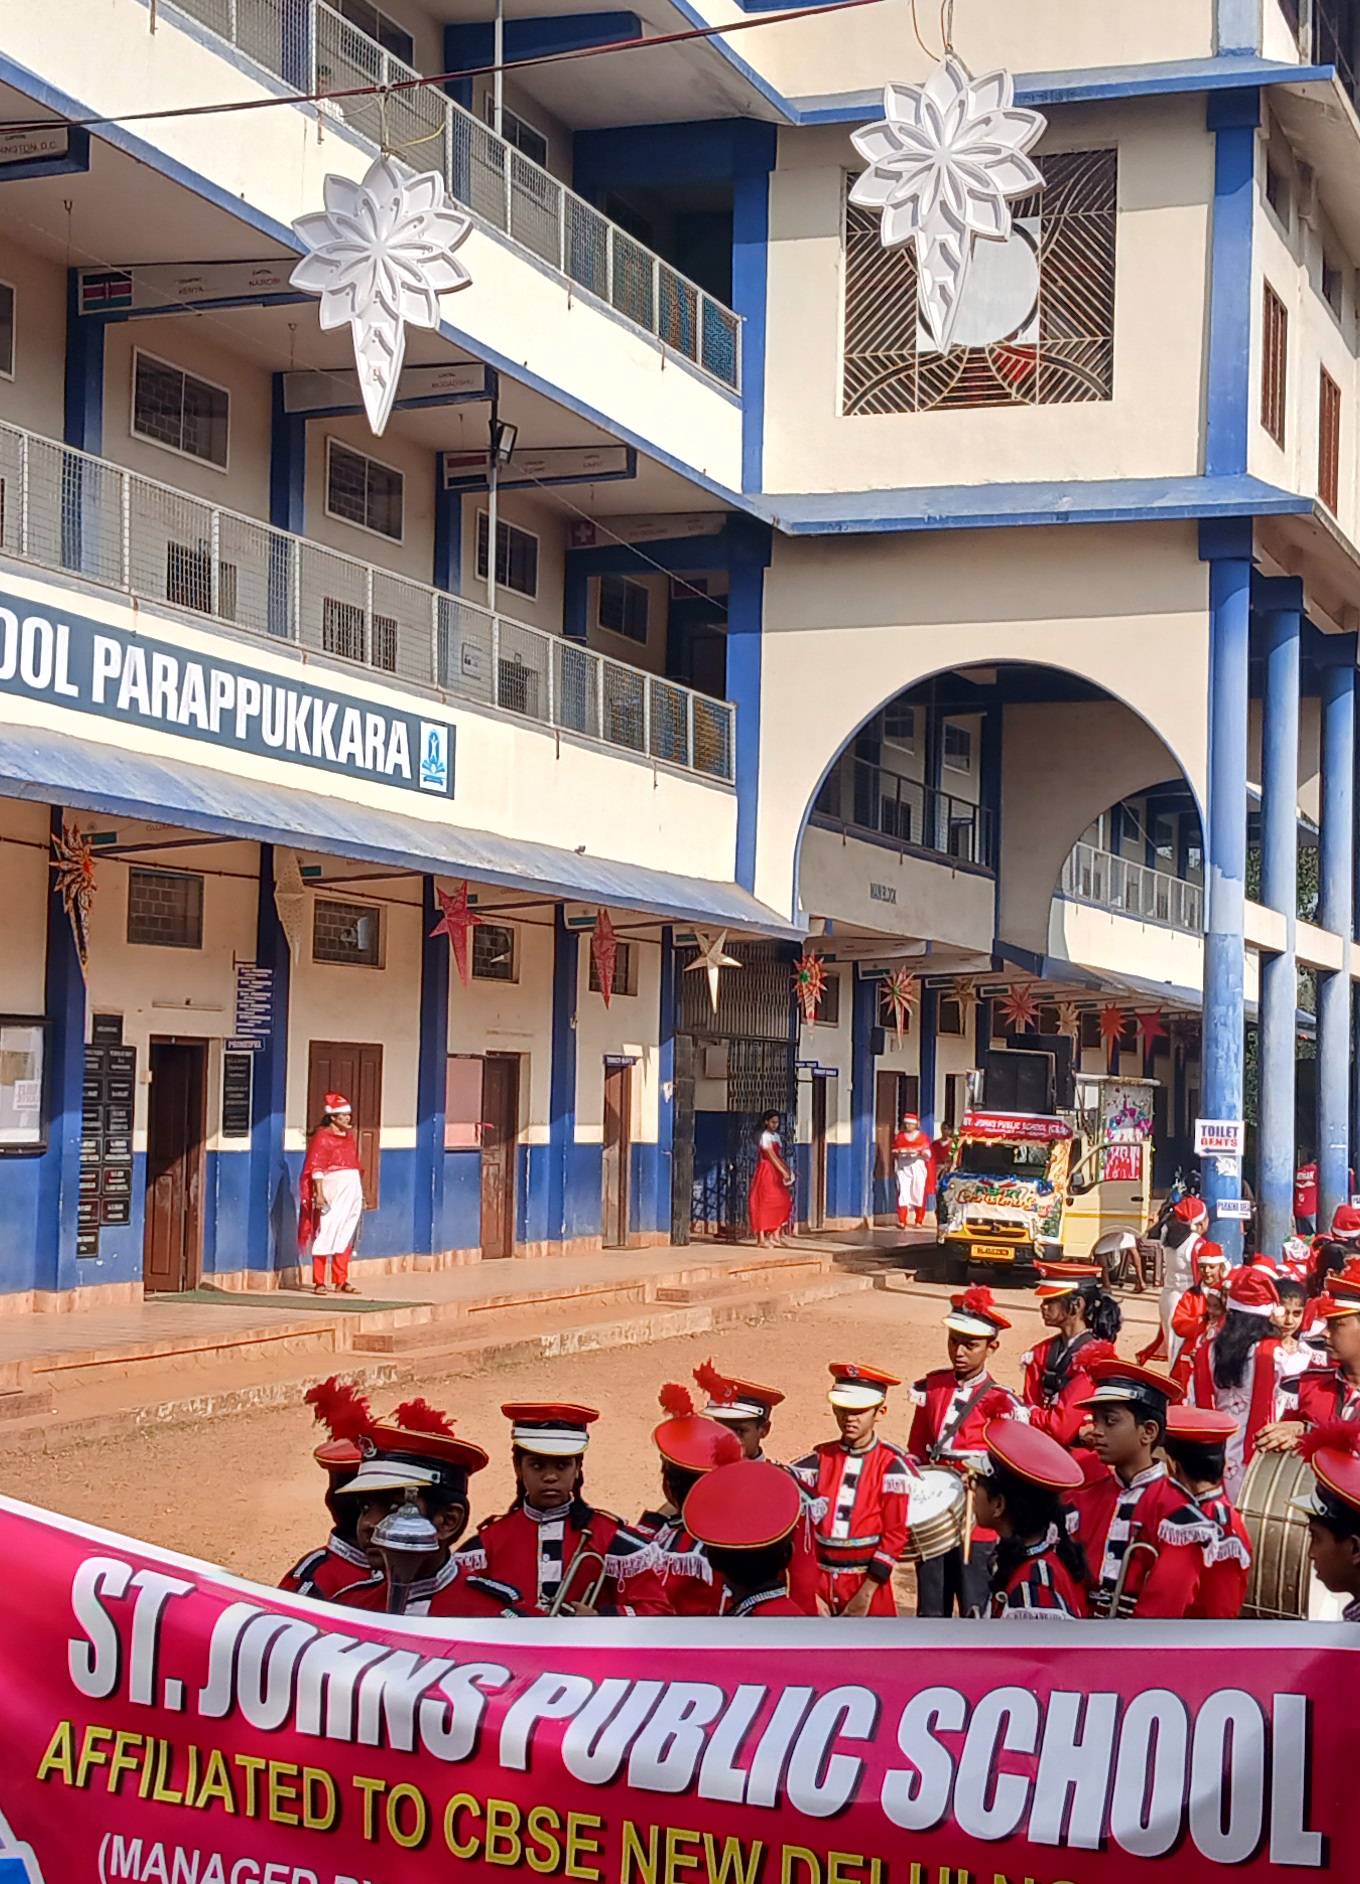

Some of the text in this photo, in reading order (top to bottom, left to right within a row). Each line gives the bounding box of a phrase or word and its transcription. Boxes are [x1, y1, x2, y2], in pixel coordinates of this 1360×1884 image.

[92, 634, 412, 780] PARAPPUKKARA
[1201, 1125, 1239, 1137] TOILET
[1201, 1138, 1238, 1147] GENTS
[68, 1556, 1323, 1869] ST. JOHNS PUBLIC SCHOOL
[37, 1720, 336, 1830] AFFILIATED
[352, 1775, 426, 1848] TO
[444, 1792, 600, 1882] CBSE
[622, 1820, 763, 1884] NEW
